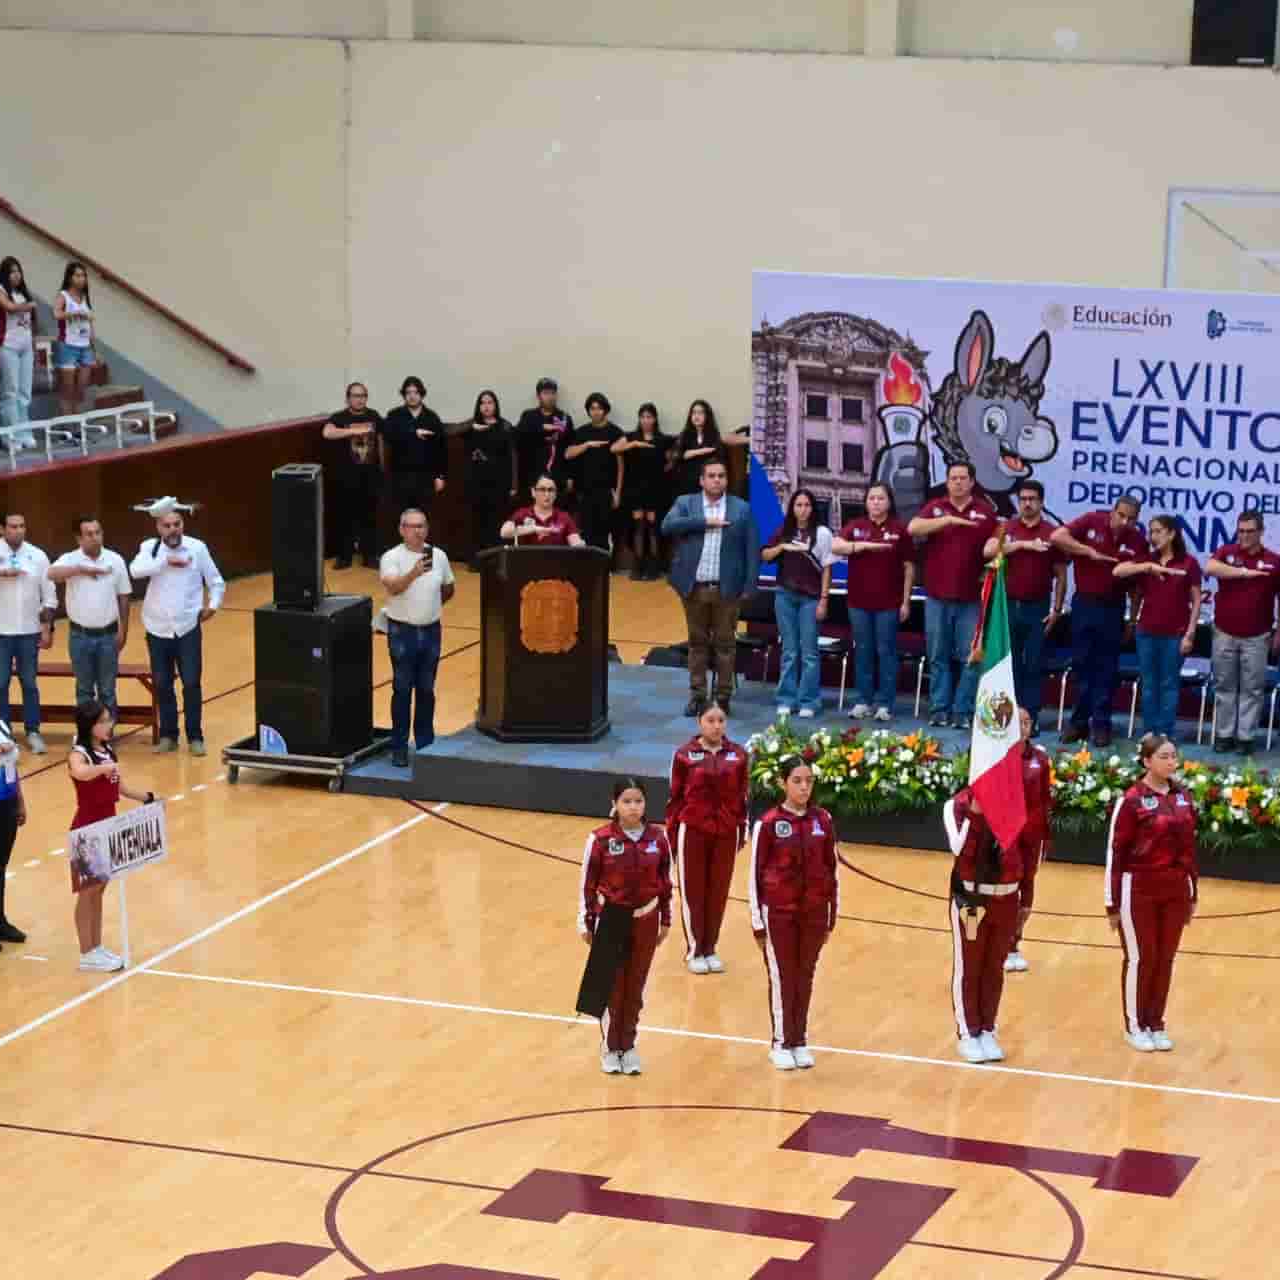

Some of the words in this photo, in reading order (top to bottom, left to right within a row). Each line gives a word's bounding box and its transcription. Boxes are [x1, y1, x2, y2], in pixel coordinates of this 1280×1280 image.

[1071, 304, 1173, 329] Educación
[1111, 357, 1244, 404] LXVIII
[1067, 480, 1235, 514] DEPORTIVO
[108, 816, 162, 867] MATEHUALA
